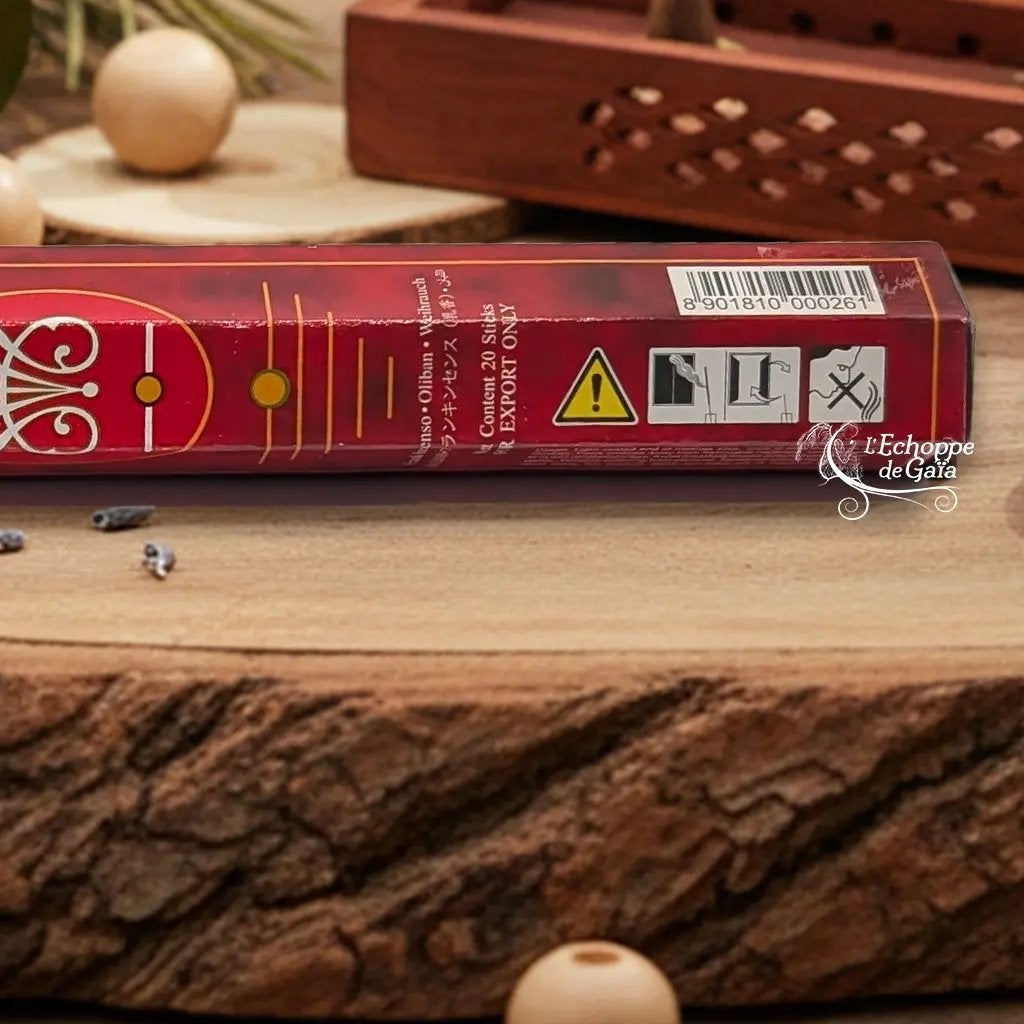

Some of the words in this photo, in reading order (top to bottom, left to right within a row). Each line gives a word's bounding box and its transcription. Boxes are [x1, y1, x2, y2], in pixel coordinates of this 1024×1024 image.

[412, 277, 433, 337] Weihrauch
[479, 303, 497, 345] Sticks
[498, 302, 519, 351] ONLY
[683, 297, 696, 311] 8
[702, 297, 782, 311] 901810
[791, 297, 869, 311] 000261
[417, 352, 434, 405] Oliban
[481, 350, 497, 372] 20
[479, 376, 496, 438] Content
[499, 356, 517, 433] EXPORT
